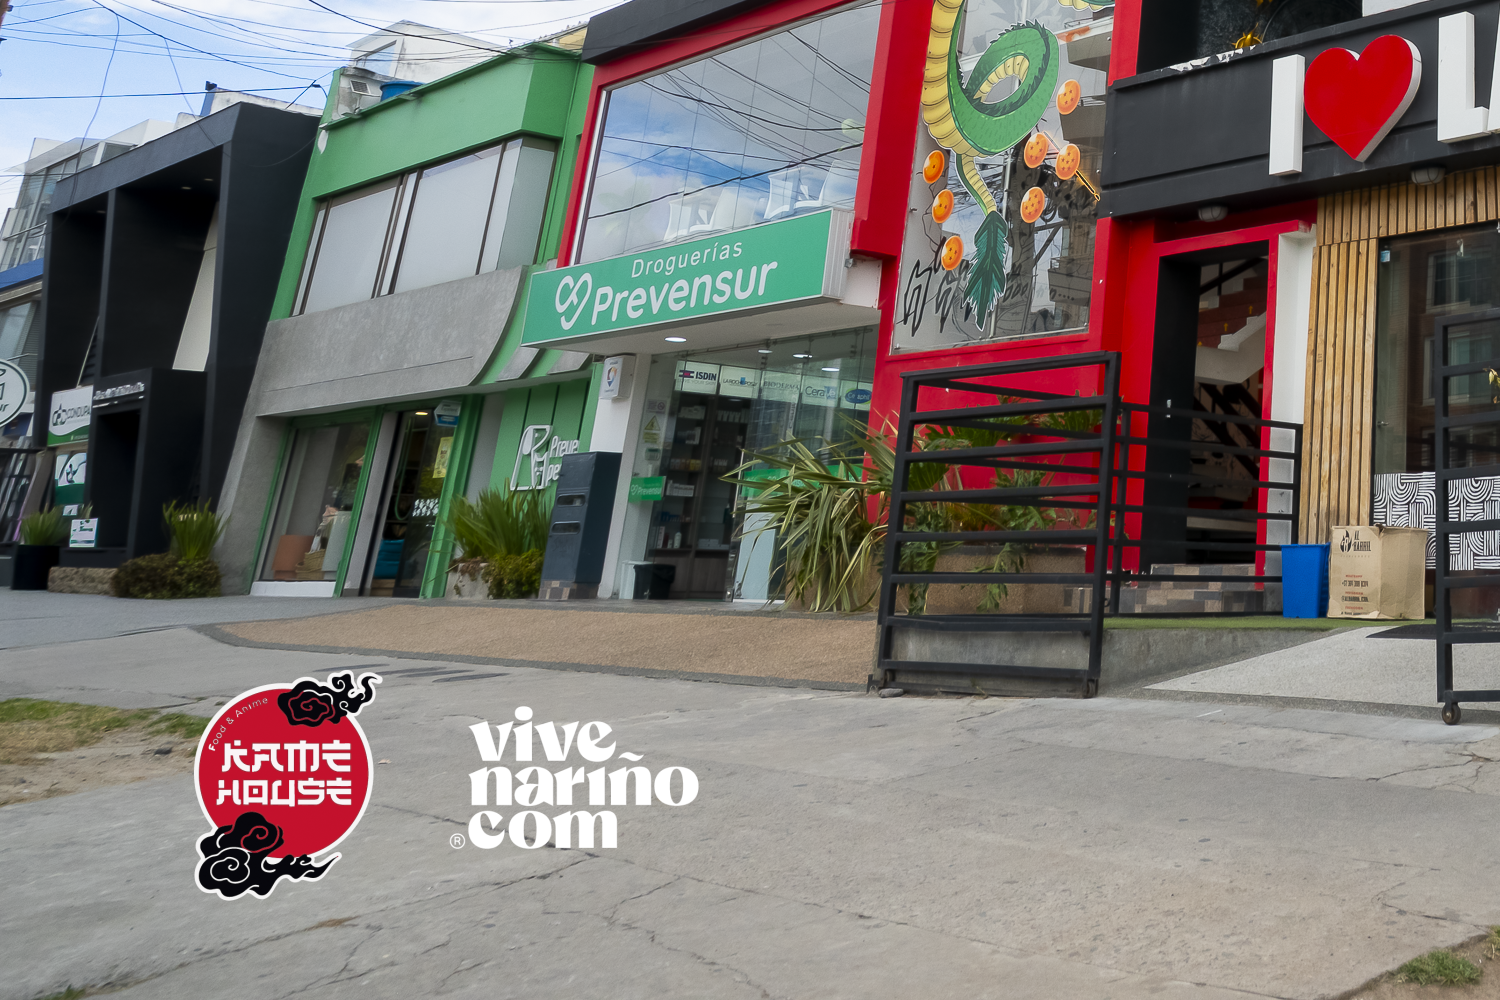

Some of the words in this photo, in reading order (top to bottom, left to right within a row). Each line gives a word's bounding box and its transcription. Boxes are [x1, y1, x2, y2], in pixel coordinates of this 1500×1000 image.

[1269, 53, 1306, 176] I
[631, 241, 743, 279] Droguerías
[591, 261, 778, 325] Prevensur
[695, 371, 717, 381] ISDIN
